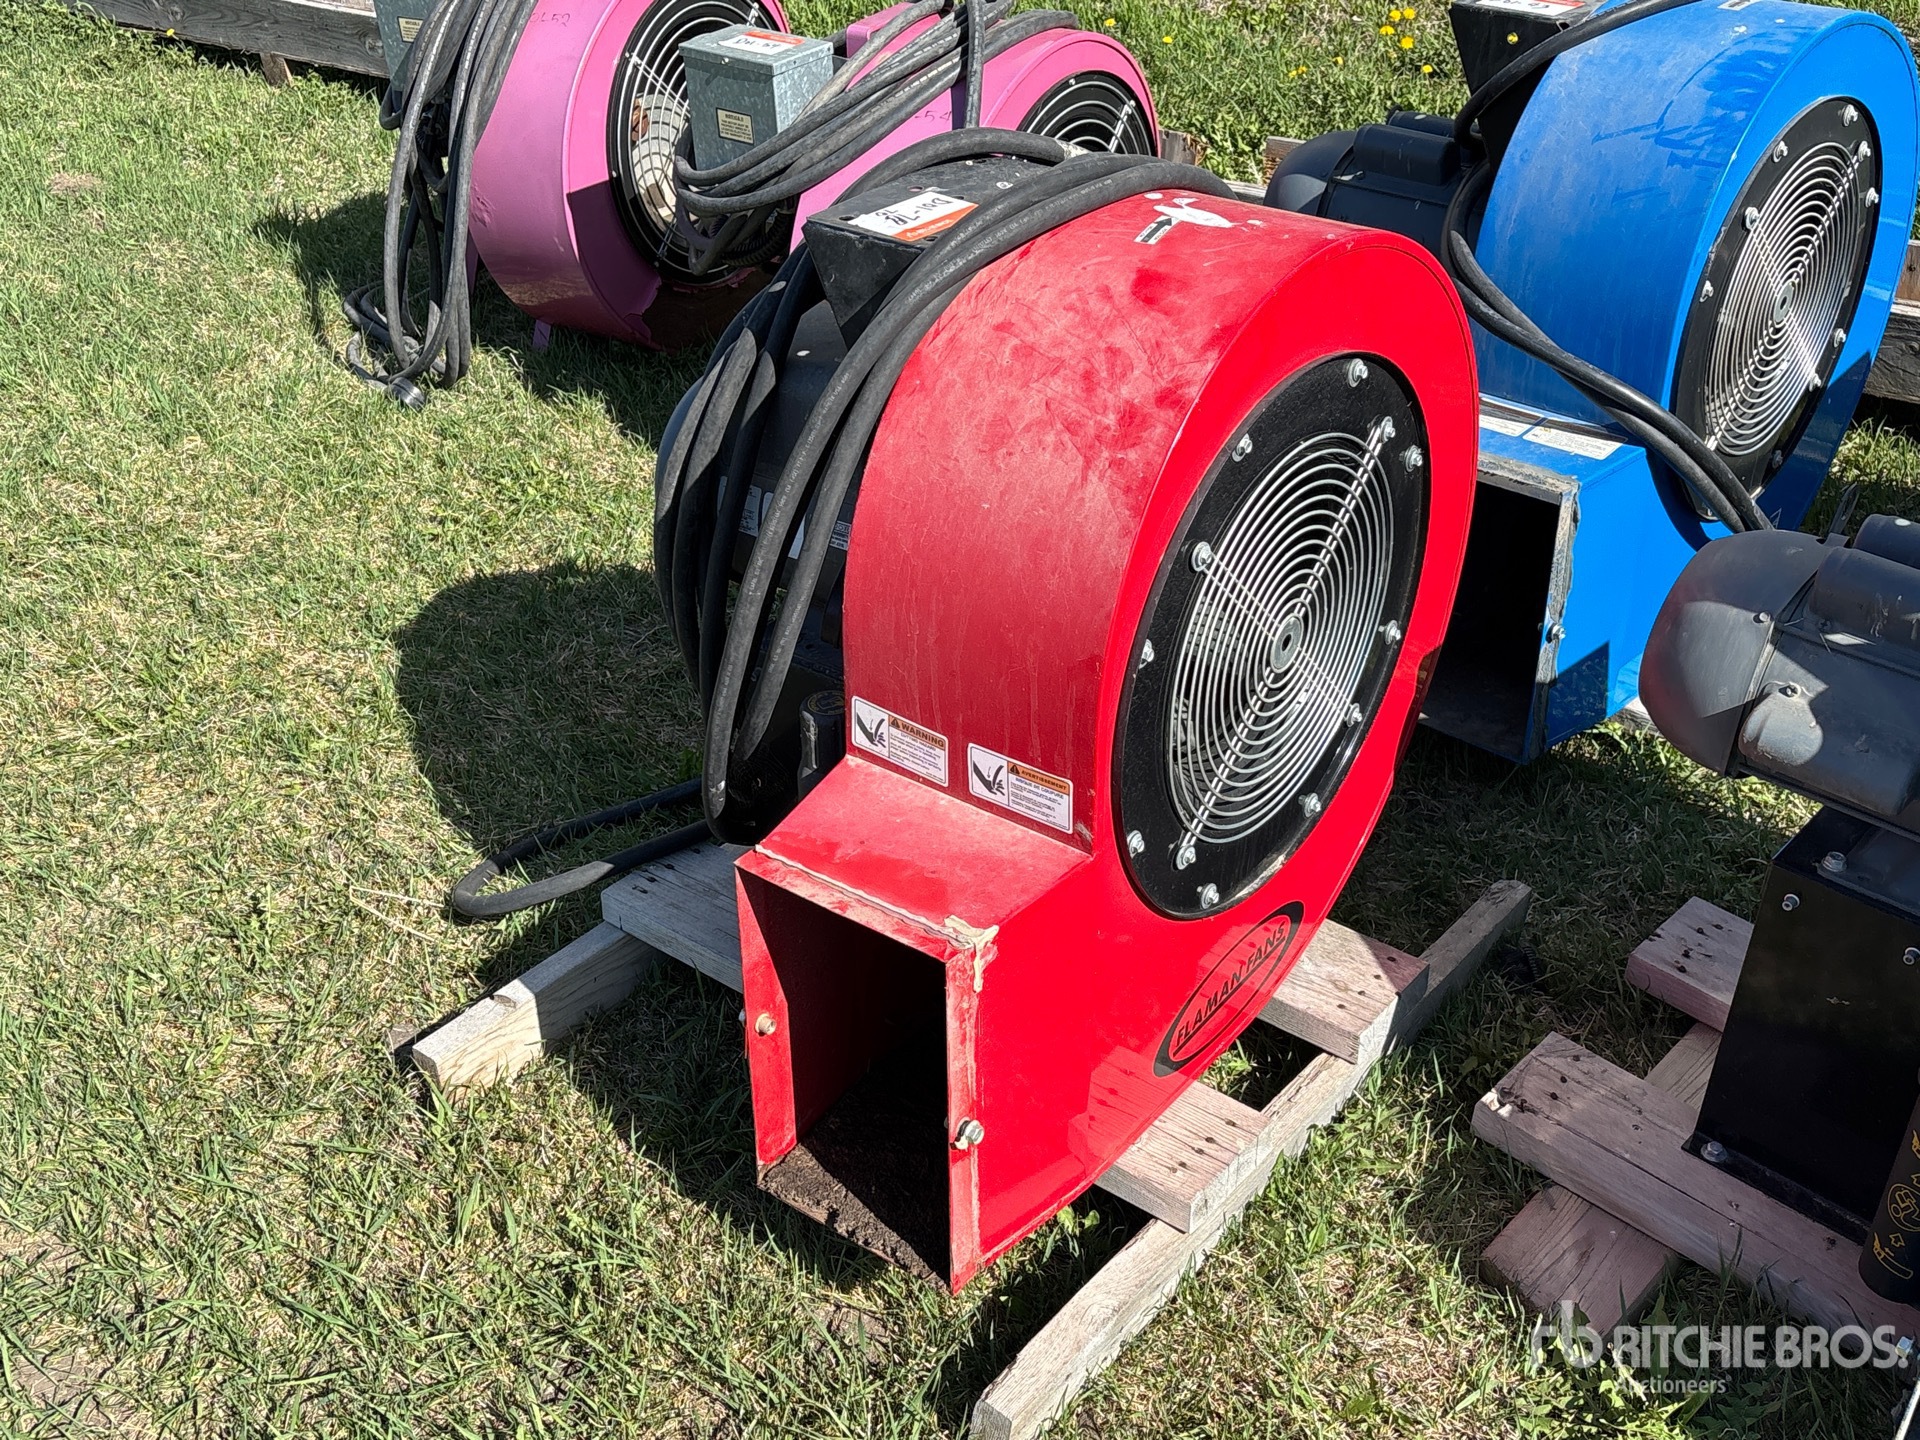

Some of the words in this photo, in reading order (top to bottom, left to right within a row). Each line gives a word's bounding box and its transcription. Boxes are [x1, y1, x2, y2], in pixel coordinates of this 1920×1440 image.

[901, 722, 944, 748] WARNING
[1021, 770, 1067, 791] AVERTISSEMENT
[1176, 964, 1244, 1047] FLAMAN
[1246, 921, 1286, 973] FANS
